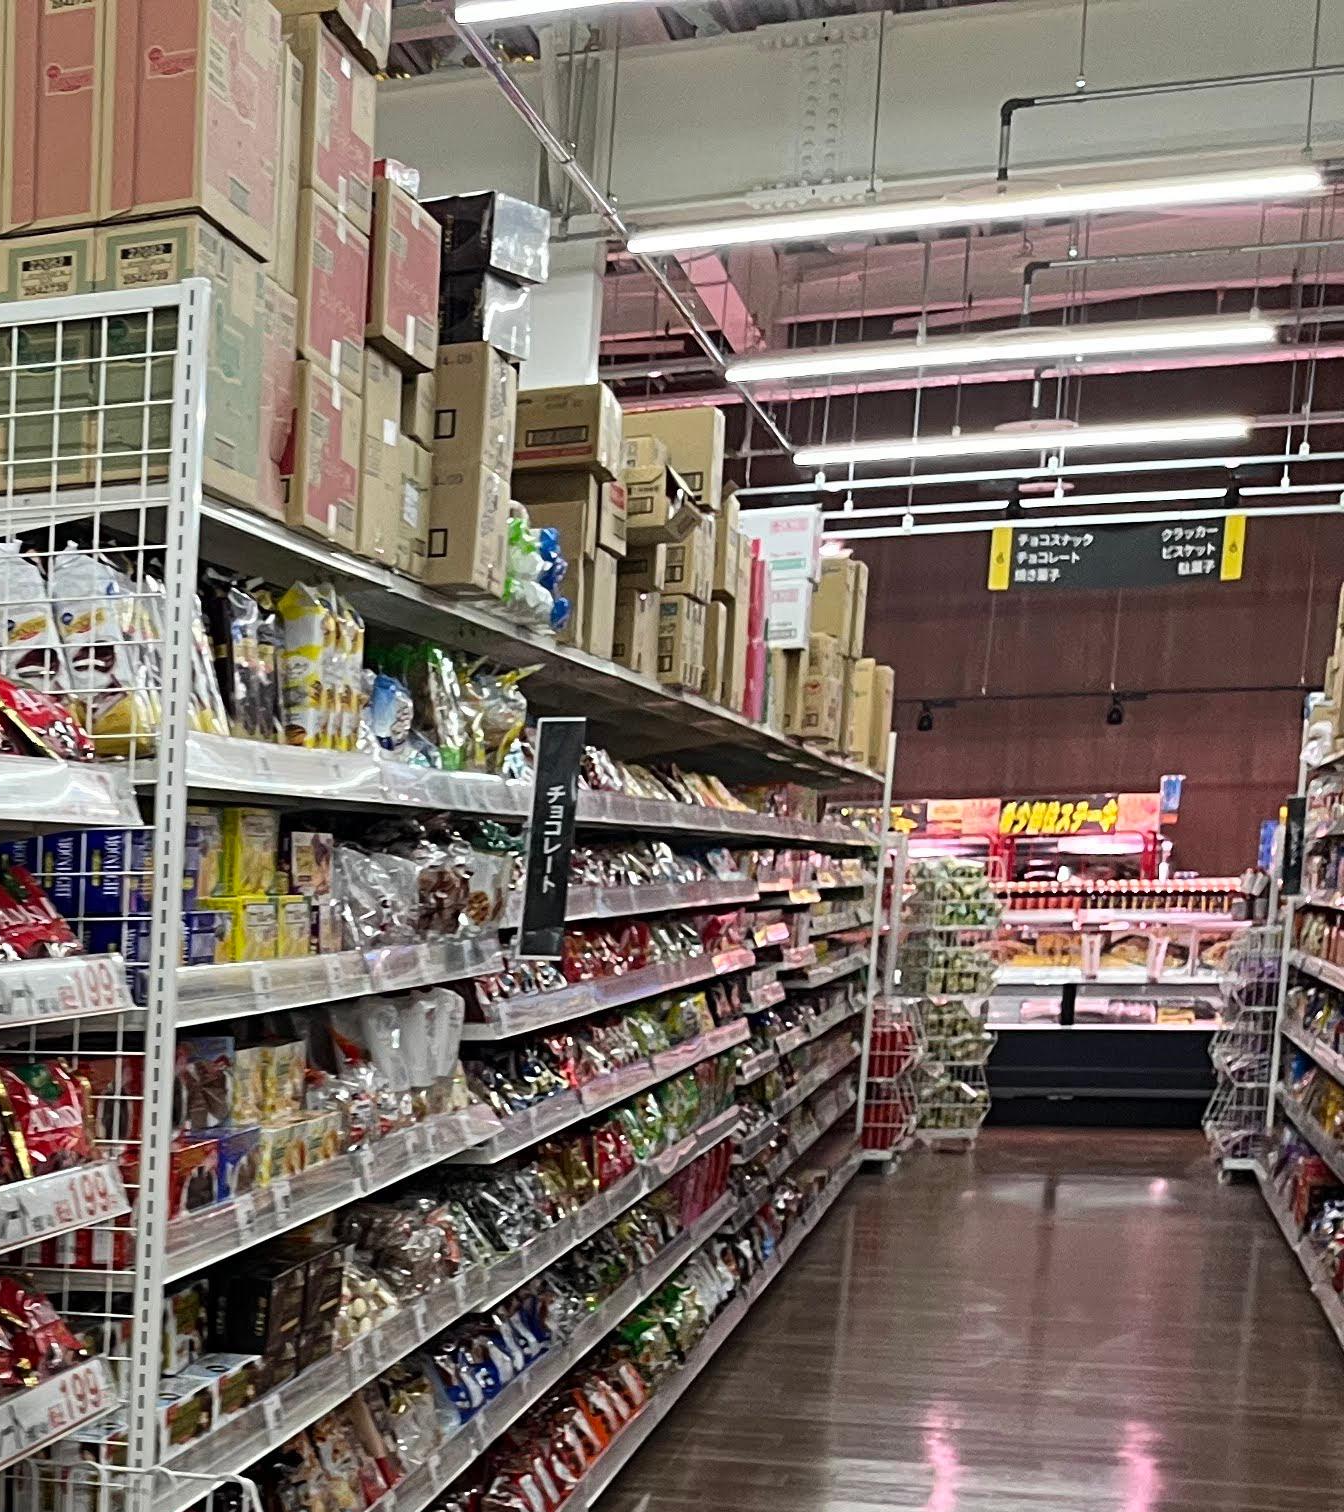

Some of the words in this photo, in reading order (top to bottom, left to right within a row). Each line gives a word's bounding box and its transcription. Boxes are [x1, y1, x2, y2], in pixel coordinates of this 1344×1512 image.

[1015, 551, 1081, 565] チョコレート
[54, 837, 74, 898] MOONLGHT
[102, 834, 122, 897] MOONLGHT
[540, 783, 567, 895] チョコレート
